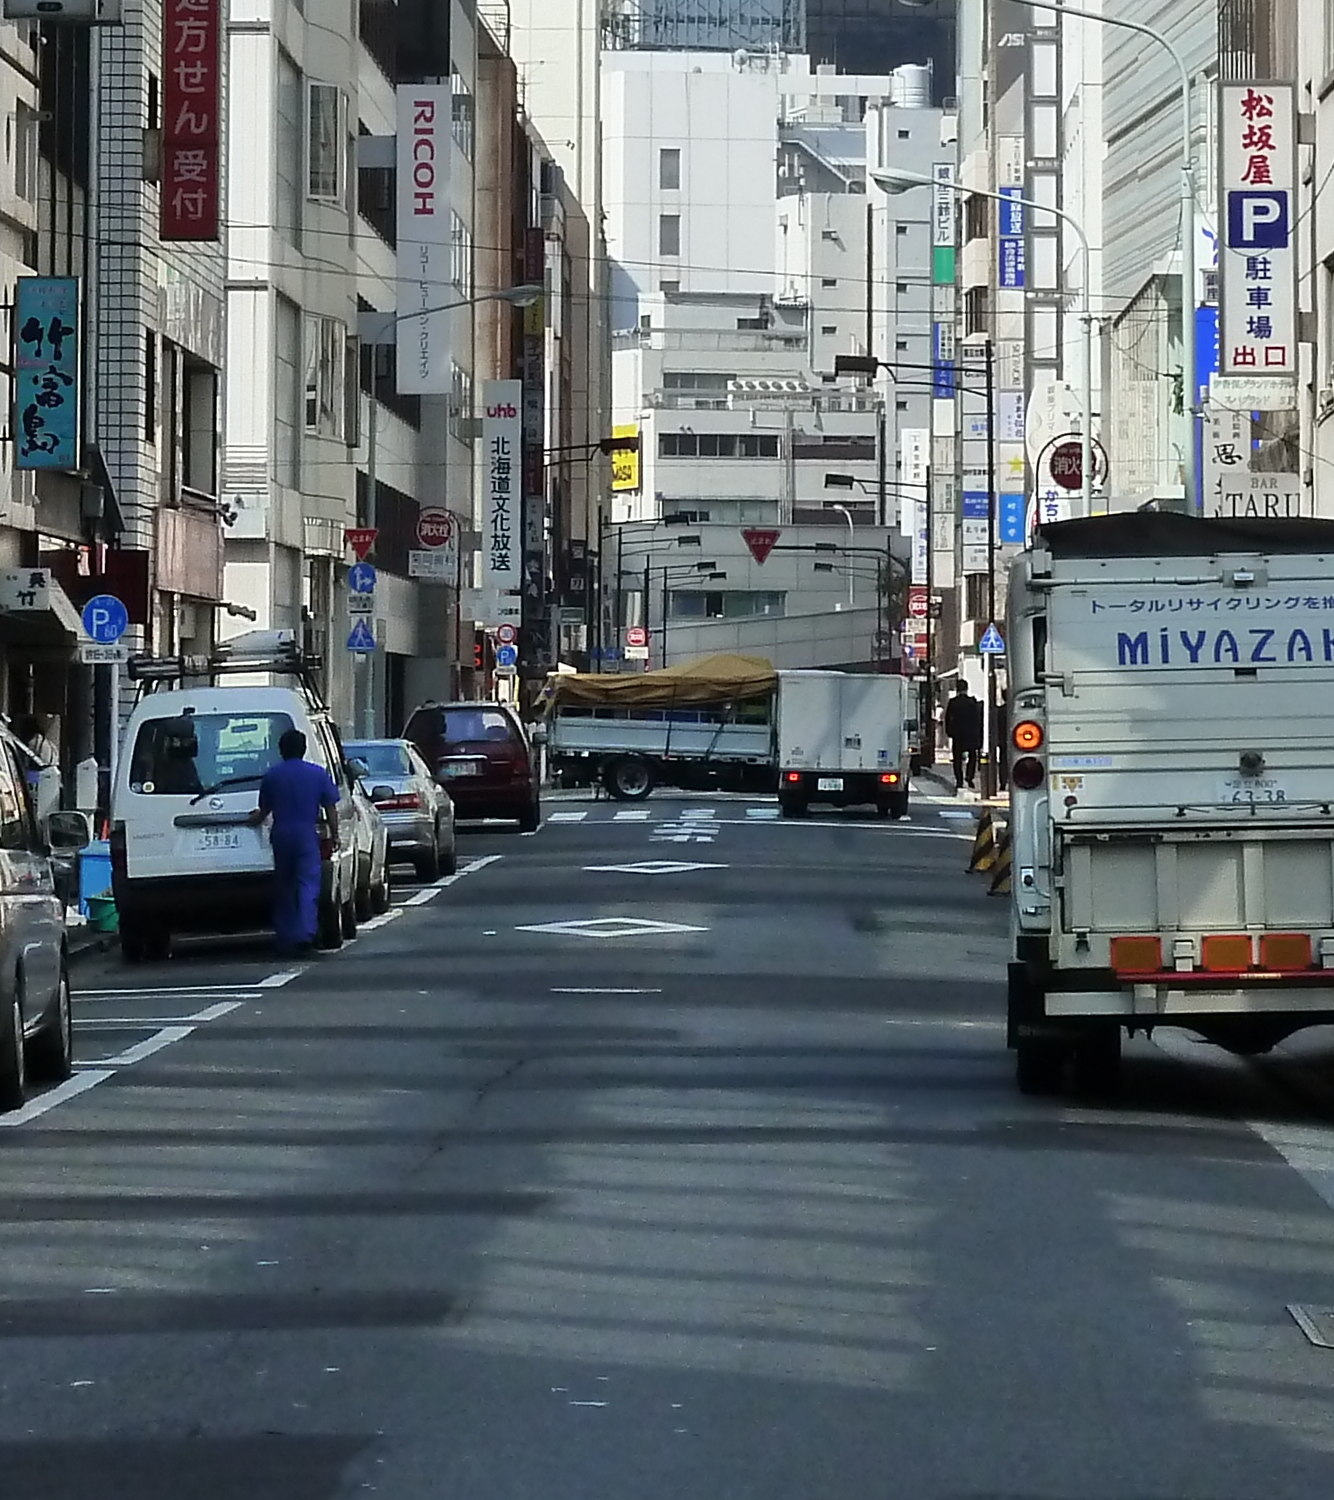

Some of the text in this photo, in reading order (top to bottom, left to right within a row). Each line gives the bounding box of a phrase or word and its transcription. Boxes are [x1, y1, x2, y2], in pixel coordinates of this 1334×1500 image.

[1241, 89, 1276, 185] 松坂屋
[413, 100, 434, 216] RICOH
[1242, 197, 1281, 242] P
[1245, 256, 1274, 340] 駐車場
[1233, 345, 1287, 367] 出口
[21, 316, 74, 457] 竹富島
[487, 403, 517, 418] uhb
[1251, 477, 1278, 489] BAR
[490, 437, 511, 572] 北海道文化放送
[1226, 492, 1301, 517] TARU
[421, 522, 451, 538] 消火栓
[93, 608, 110, 638] P
[204, 835, 239, 846] 58-84
